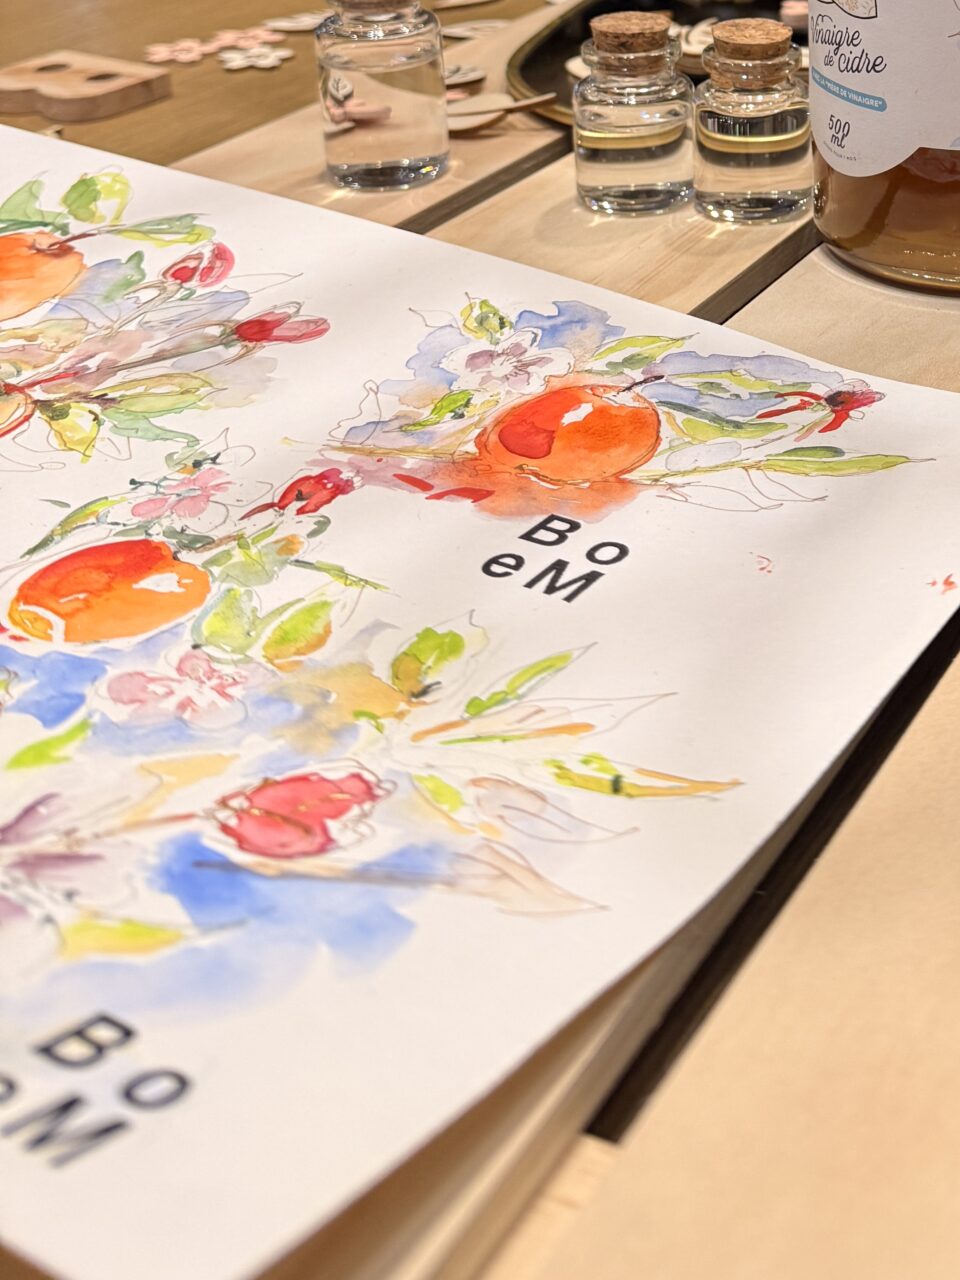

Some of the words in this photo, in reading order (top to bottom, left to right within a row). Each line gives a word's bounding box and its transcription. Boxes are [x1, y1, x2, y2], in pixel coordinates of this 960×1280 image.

[810, 13, 862, 56] Vinaigre
[823, 49, 835, 67] de
[828, 114, 851, 138] 500
[830, 133, 846, 149] ml
